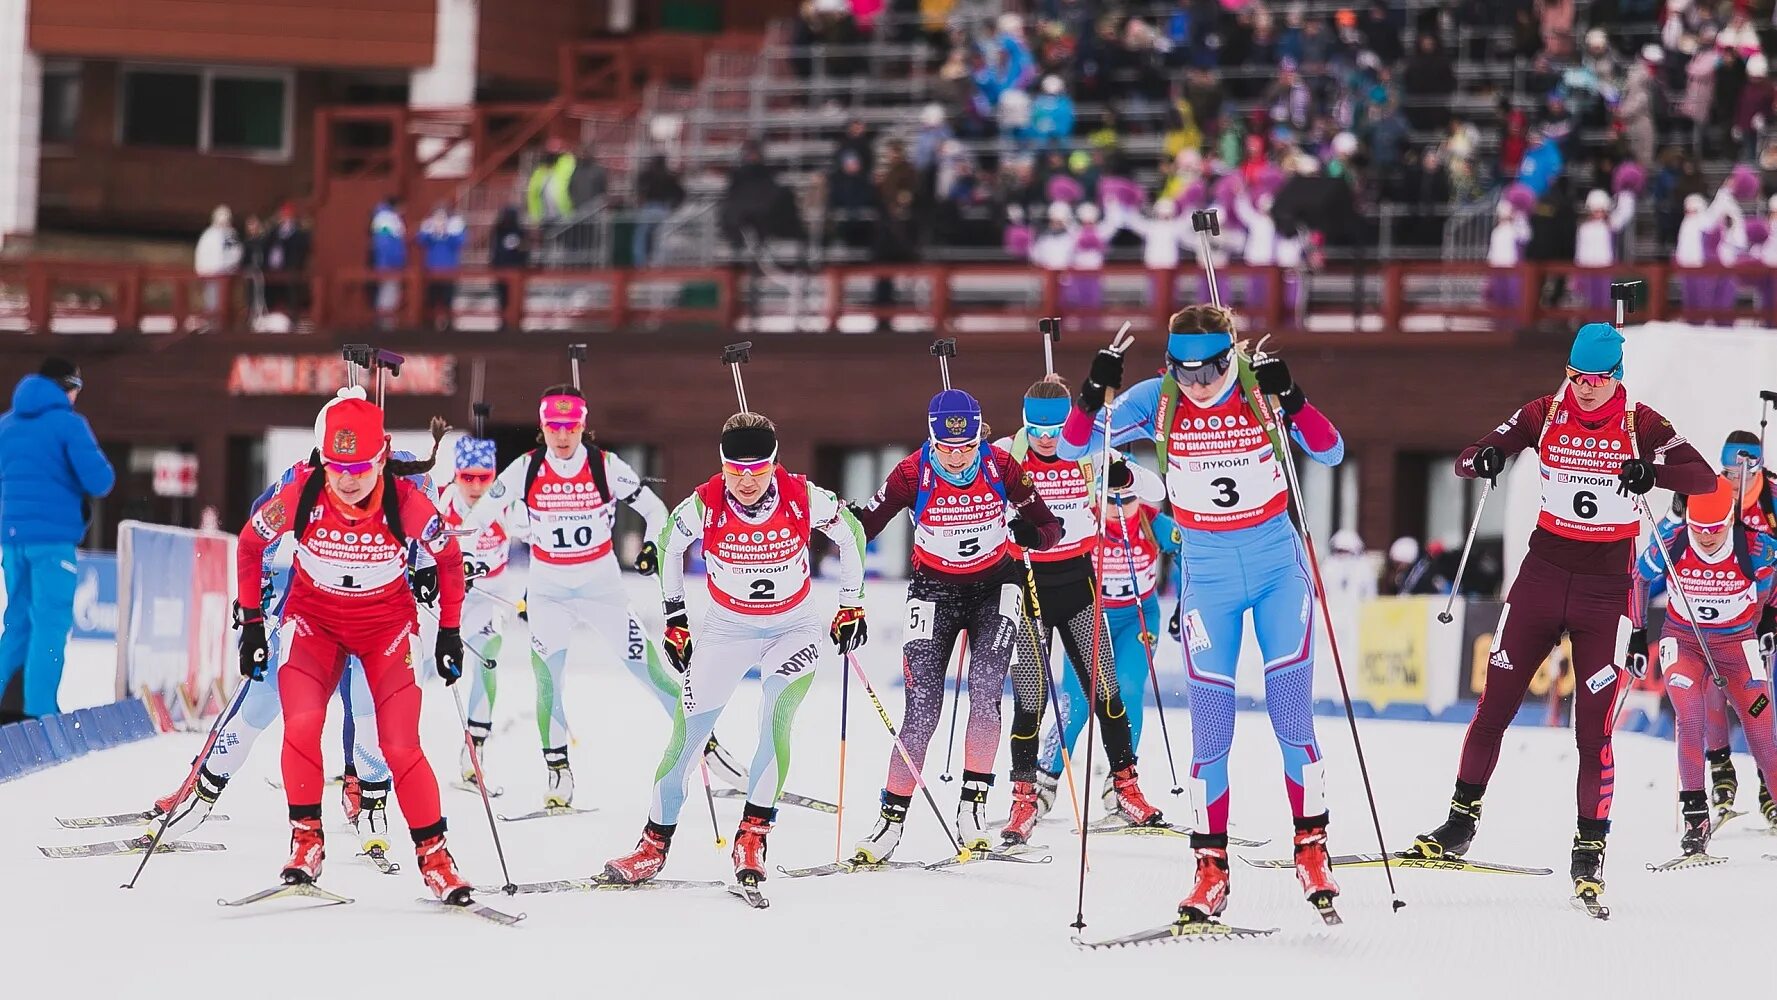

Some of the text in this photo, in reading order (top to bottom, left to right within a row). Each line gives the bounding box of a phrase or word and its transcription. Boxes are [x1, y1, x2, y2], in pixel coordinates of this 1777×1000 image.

[1170, 425, 1264, 441] ЧЕМПИОНАТ РОССИИ
[1173, 436, 1263, 451] ПО БИАТЛОНУ 2018
[1548, 444, 1632, 461] ЧЕМПИОНАТ РОССИИ
[1202, 458, 1250, 470] ЛУКОЙЛ
[1549, 453, 1560, 462] ПО
[1560, 455, 1605, 467] БИАТЛОНУ
[1606, 461, 1622, 469] 201
[1569, 475, 1613, 487] ЛУКОЙЛ
[1210, 477, 1240, 508] 3
[926, 499, 1004, 515] ЧЕМПИОНАТ РОССИИ
[1048, 503, 1077, 511] УКОЙЛ
[1573, 490, 1598, 519] 6
[929, 514, 941, 522] ПО
[942, 512, 984, 522] БИАТЛОНУ
[985, 505, 1002, 517] 2018
[552, 525, 593, 549] 10
[953, 524, 993, 536] ЛУКОЙЛ
[770, 534, 801, 550] РОССИИ
[958, 537, 981, 557] 5
[719, 544, 799, 560] ПО БИАТЛОНУ 2018
[745, 565, 789, 574] ЛУКОЙЛ
[333, 574, 362, 588] 1
[749, 579, 775, 600] 2
[1697, 605, 1720, 620] 9
[1490, 658, 1513, 671] adidas
[1124, 828, 1165, 836] FISCHER
[633, 857, 661, 871] alpina
[1400, 859, 1465, 871] FISCHER
[1183, 924, 1232, 937] FISCHER
